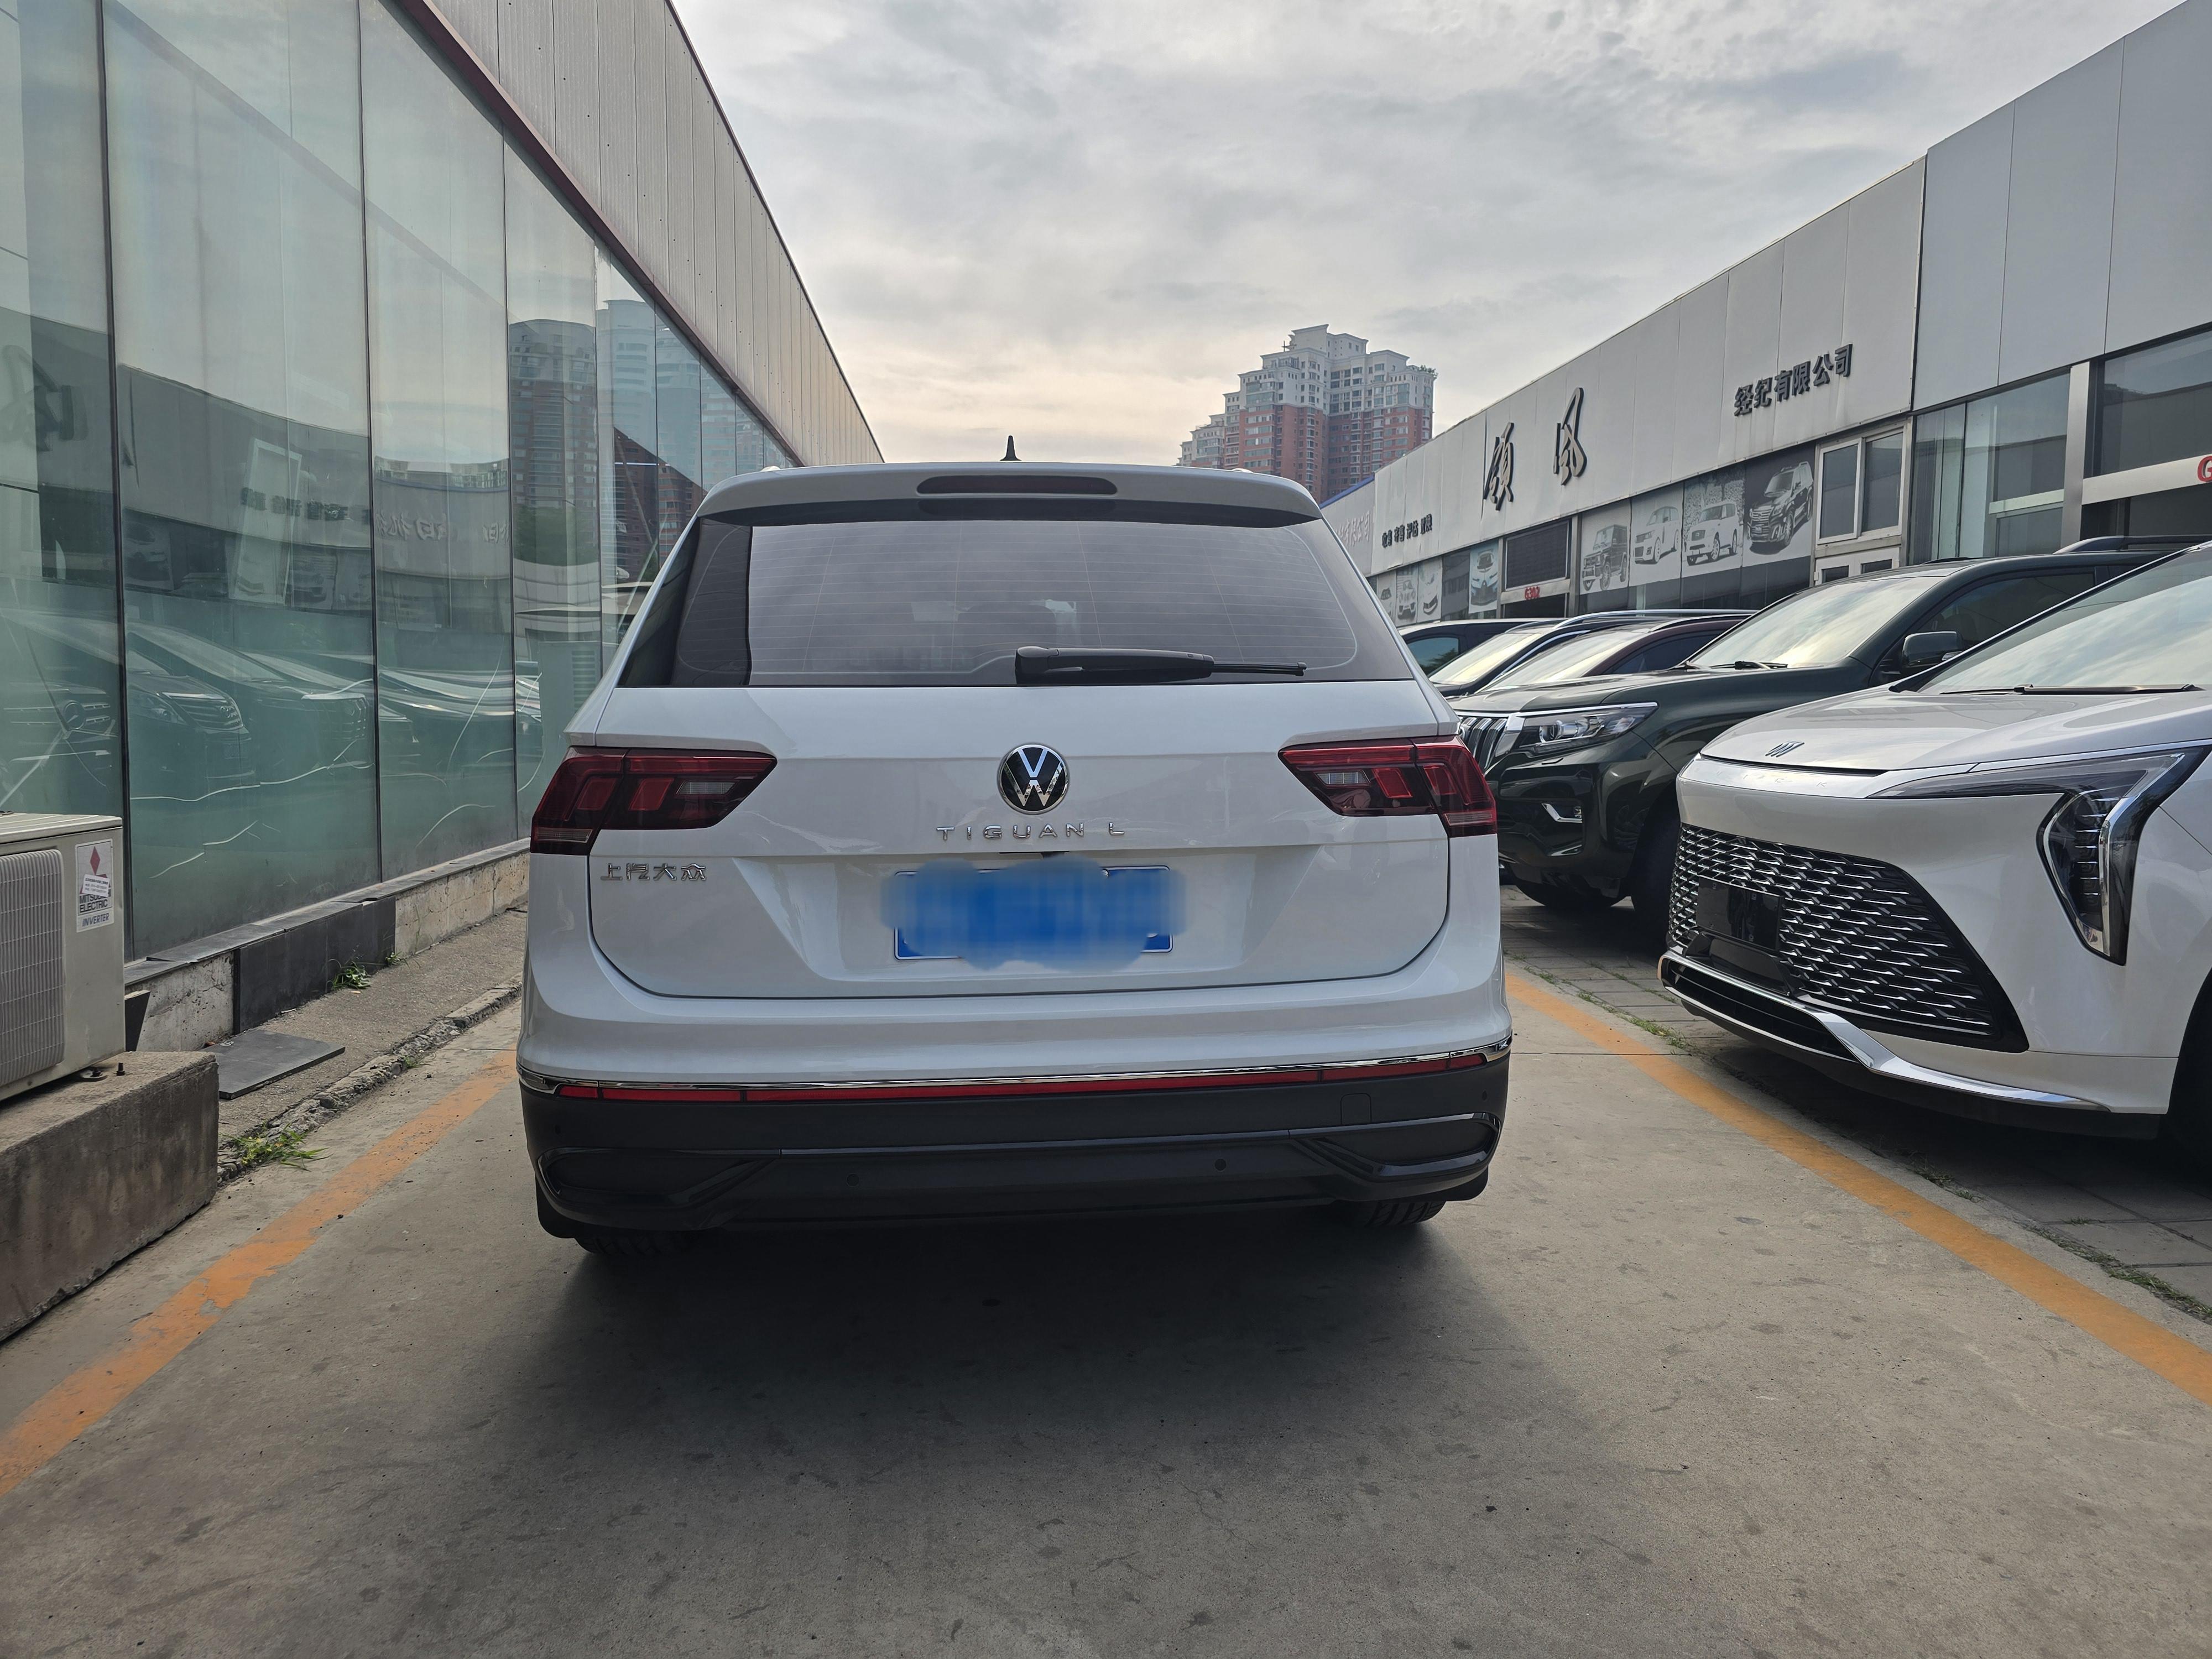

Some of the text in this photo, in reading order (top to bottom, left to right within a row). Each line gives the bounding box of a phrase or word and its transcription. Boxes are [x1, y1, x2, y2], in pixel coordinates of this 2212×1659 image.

[1734, 343, 1853, 416] 经纪有限公司
[936, 822, 1125, 841] TIGUAN L
[601, 863, 706, 881] 上汽大众
[79, 899, 108, 913] ELECTRIC
[82, 912, 109, 927] INVERTER
